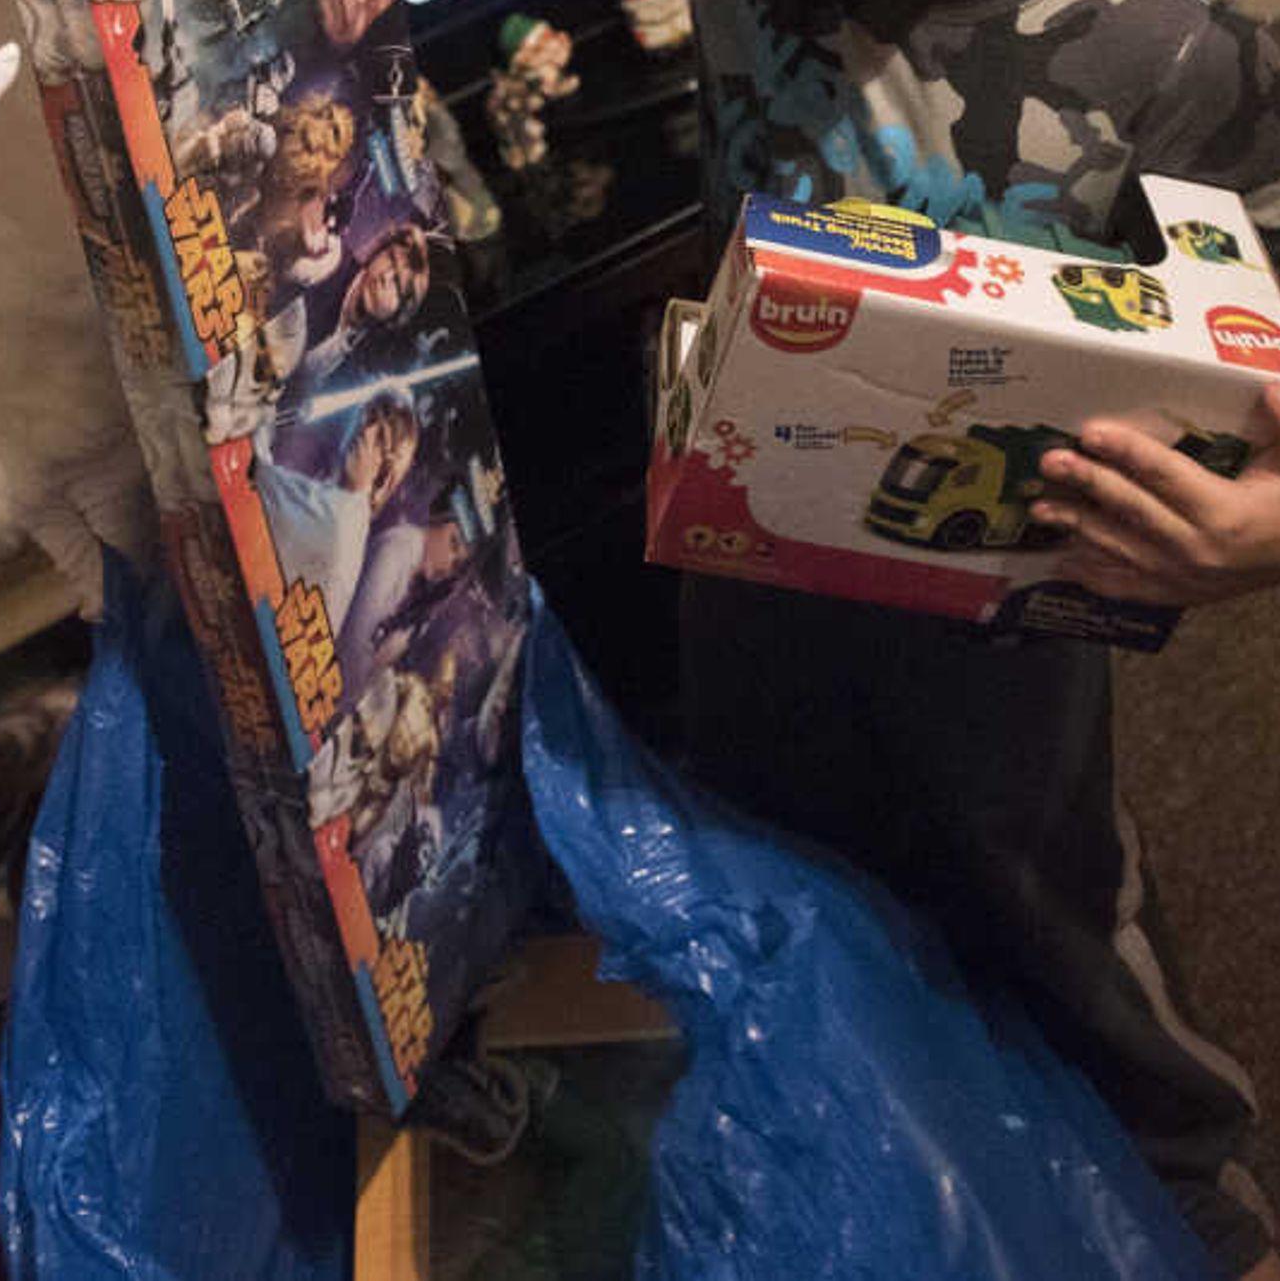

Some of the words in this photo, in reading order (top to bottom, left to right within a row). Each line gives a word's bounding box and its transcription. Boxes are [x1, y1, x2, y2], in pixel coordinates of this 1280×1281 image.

[163, 183, 222, 340] WARS
[184, 177, 245, 339] STAR
[759, 295, 848, 325] bruin
[277, 583, 320, 733] WARS
[294, 577, 344, 726] STAR
[374, 947, 411, 1077] WARS
[388, 939, 434, 1067] STAR
